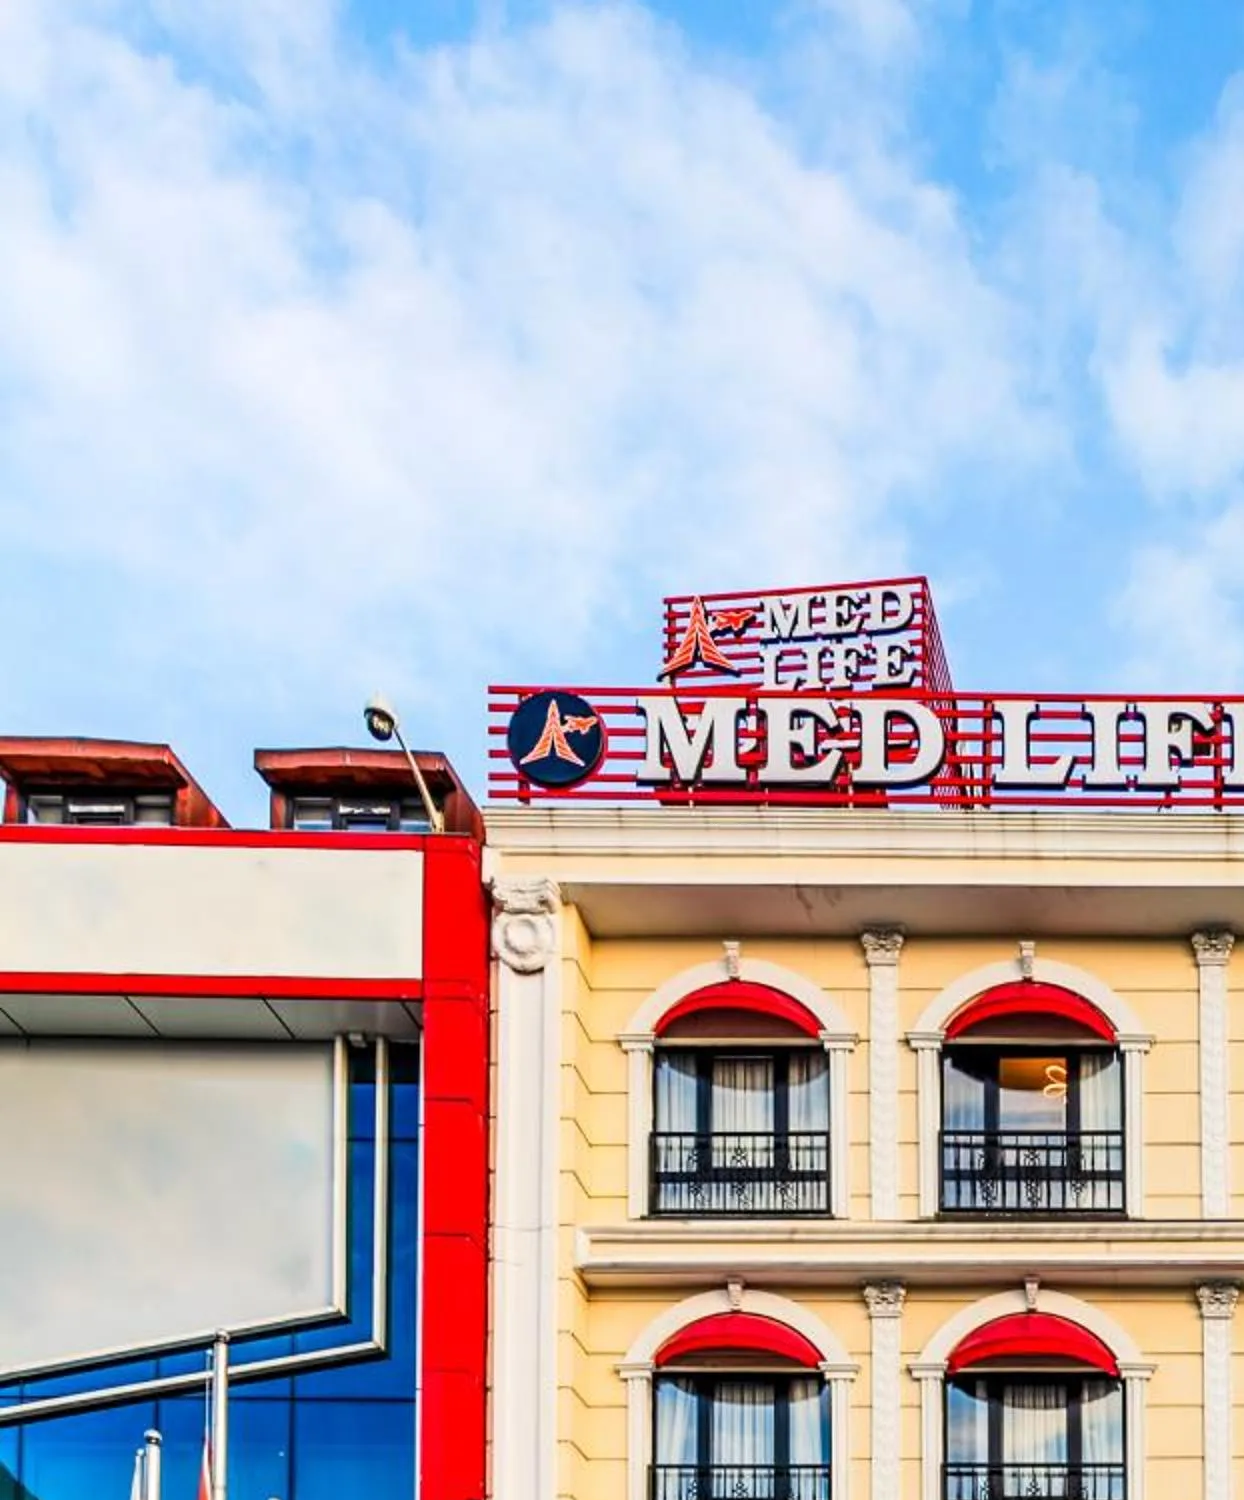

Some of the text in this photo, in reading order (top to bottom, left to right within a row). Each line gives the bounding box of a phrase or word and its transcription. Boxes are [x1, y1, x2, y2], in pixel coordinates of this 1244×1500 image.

[760, 586, 915, 644] MED
[759, 638, 916, 692] LIFE
[636, 697, 946, 789] MED
